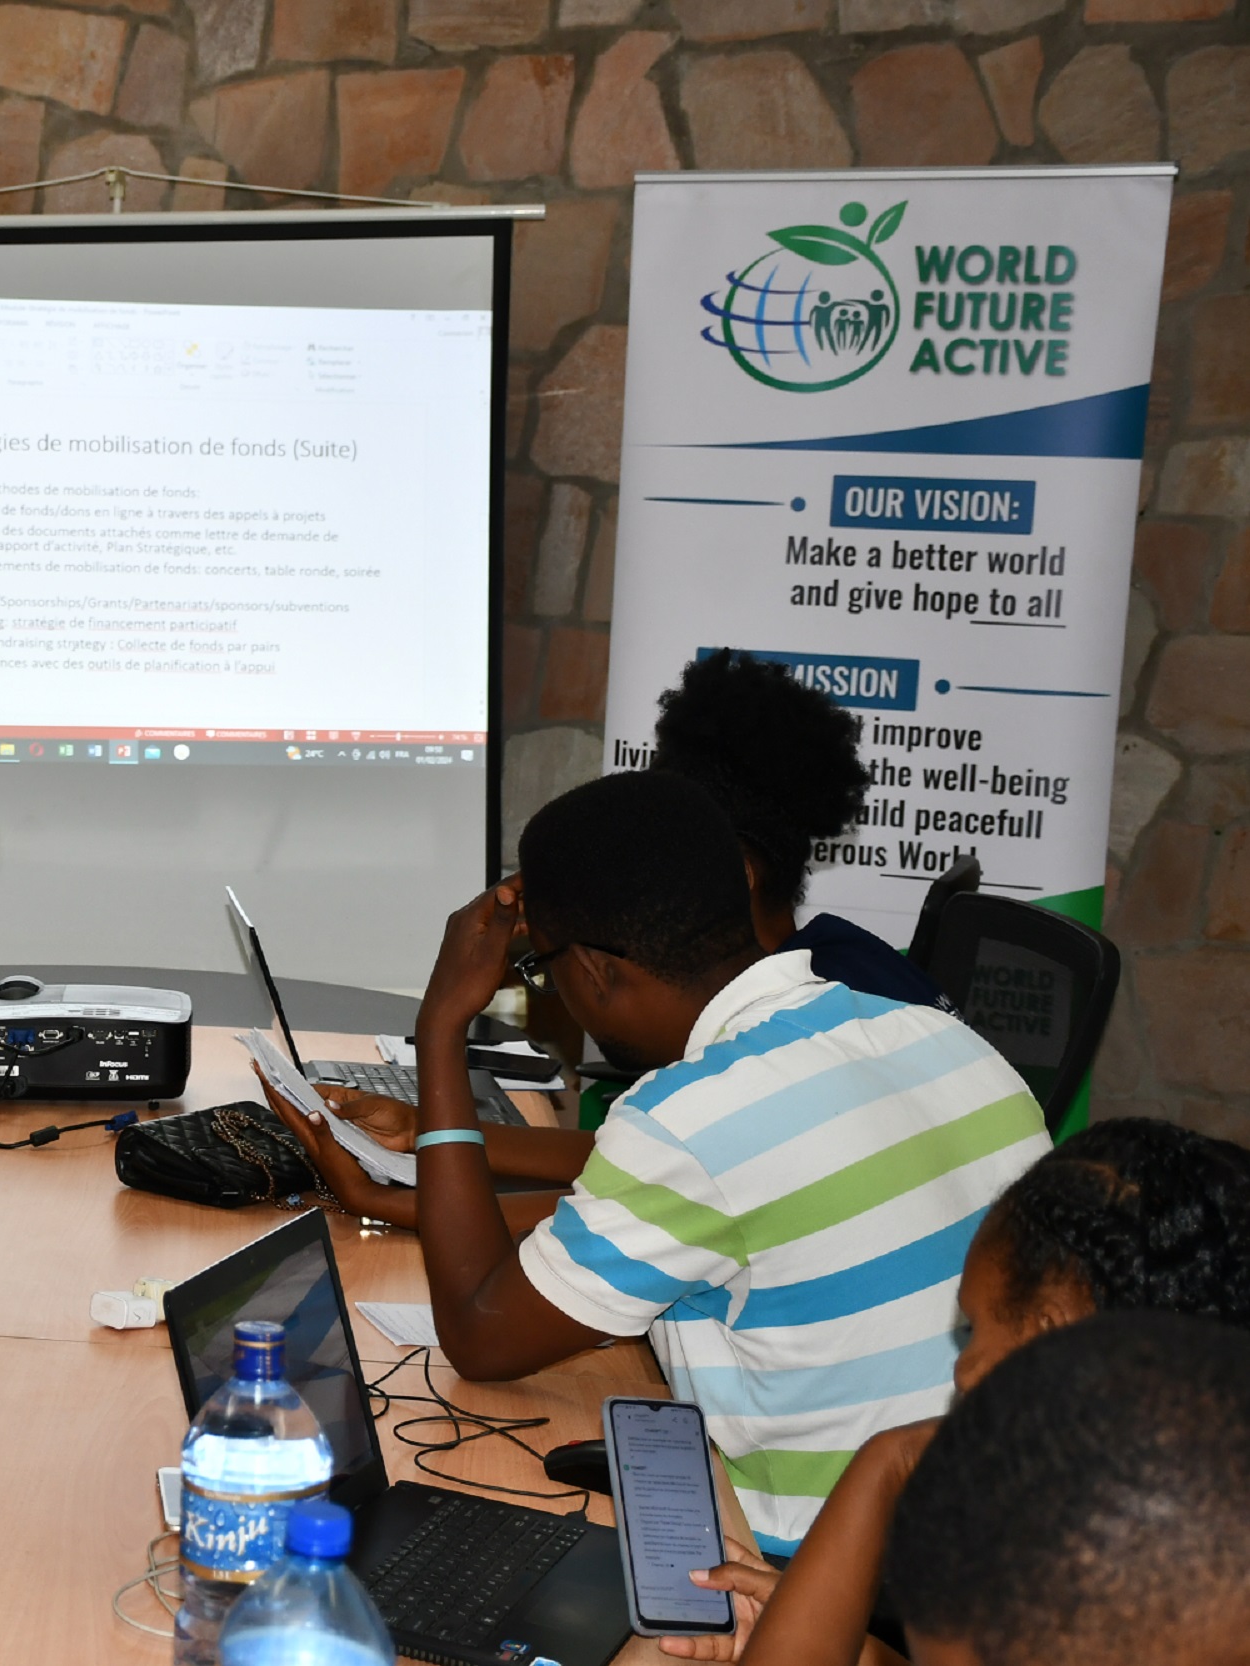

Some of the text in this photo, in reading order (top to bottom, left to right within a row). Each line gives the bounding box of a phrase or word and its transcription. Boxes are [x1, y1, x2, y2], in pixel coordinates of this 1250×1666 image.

[915, 245, 1078, 286] WORLD
[913, 291, 1075, 331] FUTURE
[909, 338, 1070, 377] ACTIVE
[37, 434, 62, 452] de
[69, 435, 193, 456] mobilisation
[199, 438, 225, 456] de
[231, 438, 286, 458] fonds
[293, 439, 358, 462] (Suite)
[44, 484, 59, 496] de
[63, 485, 140, 497] mobilisation
[143, 486, 158, 498] de
[162, 487, 200, 499] fonds:
[845, 486, 1020, 523] OUR VISION:
[2, 504, 16, 516] de
[20, 504, 91, 518] fonds/dons
[95, 508, 110, 518] en
[114, 506, 143, 521] ligne
[148, 507, 154, 519] à
[158, 509, 200, 520] travers
[204, 508, 225, 520] des
[228, 509, 269, 524] appels
[272, 510, 279, 521] à
[283, 510, 326, 525] projets
[2, 524, 24, 536] des
[27, 525, 96, 538] documents
[99, 526, 152, 539] attachés
[155, 529, 201, 540] comme
[205, 529, 239, 541] lettre
[243, 530, 258, 541] de
[261, 530, 320, 543] demande
[323, 531, 339, 543] de
[107, 541, 133, 554] Plan
[136, 542, 212, 557] Stratégique,
[785, 536, 1066, 576] Make a better world
[45, 560, 60, 572] de
[64, 560, 141, 574] mobilisation
[144, 562, 159, 574] de
[205, 564, 261, 577] concerts,
[265, 565, 296, 577] table
[299, 566, 340, 579] ronde,
[343, 566, 381, 578] soirée
[790, 579, 1063, 620] and give hope to all
[12, 616, 66, 631] stratégie
[69, 617, 85, 629] de
[88, 618, 166, 631] financement
[170, 619, 238, 633] participatif
[117, 639, 167, 652] Collecte
[171, 640, 186, 652] de
[189, 640, 224, 652] fonds
[227, 643, 246, 654] par
[251, 641, 281, 655] pairs
[31, 660, 59, 670] avec
[63, 658, 84, 670] des
[88, 659, 122, 671] outils
[125, 659, 140, 671] de
[144, 659, 221, 674] planification
[224, 660, 231, 672] à
[873, 716, 982, 752] improve
[614, 739, 657, 768] livi
[869, 757, 1070, 805] the well-being
[855, 799, 1044, 839] uild peacefull
[814, 841, 888, 867] erous
[974, 964, 1055, 990] WORLD
[973, 1009, 1052, 1037] ACTIVE
[185, 1510, 269, 1557] Kinju
